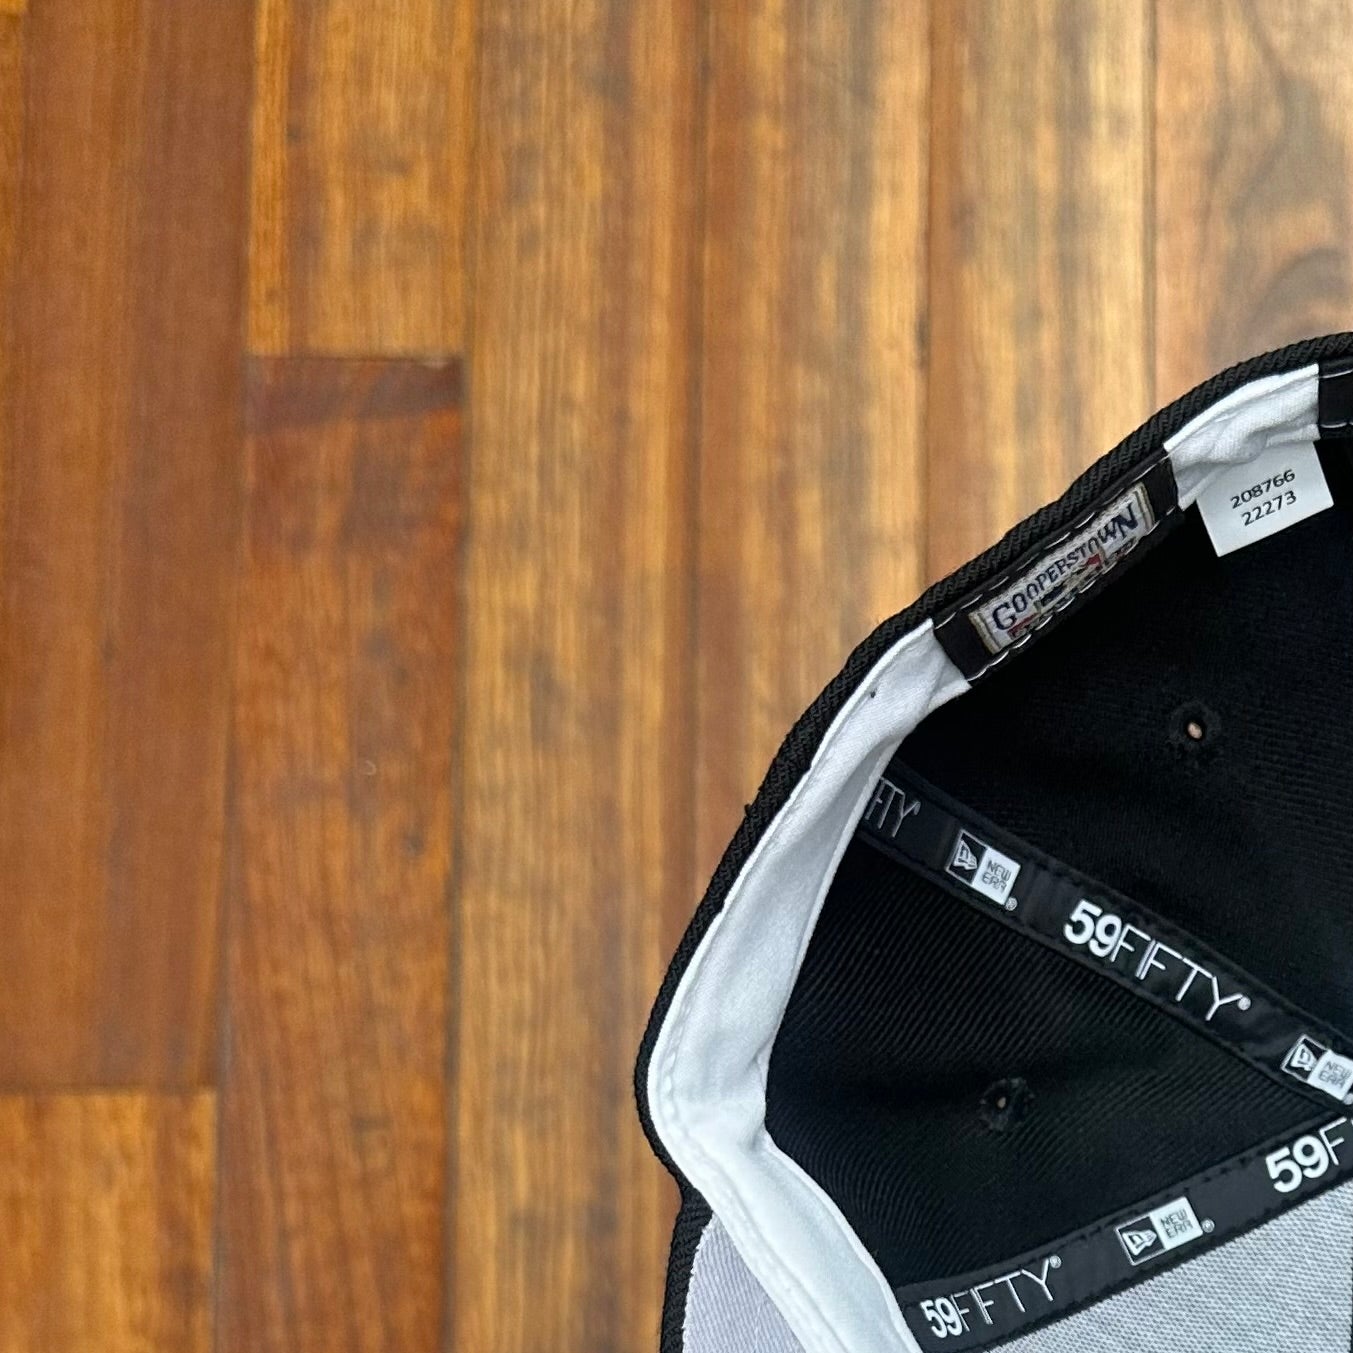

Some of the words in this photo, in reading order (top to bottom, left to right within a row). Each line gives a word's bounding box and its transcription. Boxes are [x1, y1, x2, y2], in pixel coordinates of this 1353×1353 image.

[1231, 469, 1296, 509] 208766
[1241, 490, 1297, 526] 22273
[987, 858, 1012, 882] NEW
[1064, 899, 1242, 1021] 59FIFTY
[919, 1258, 1053, 1338] 59FIFTY
